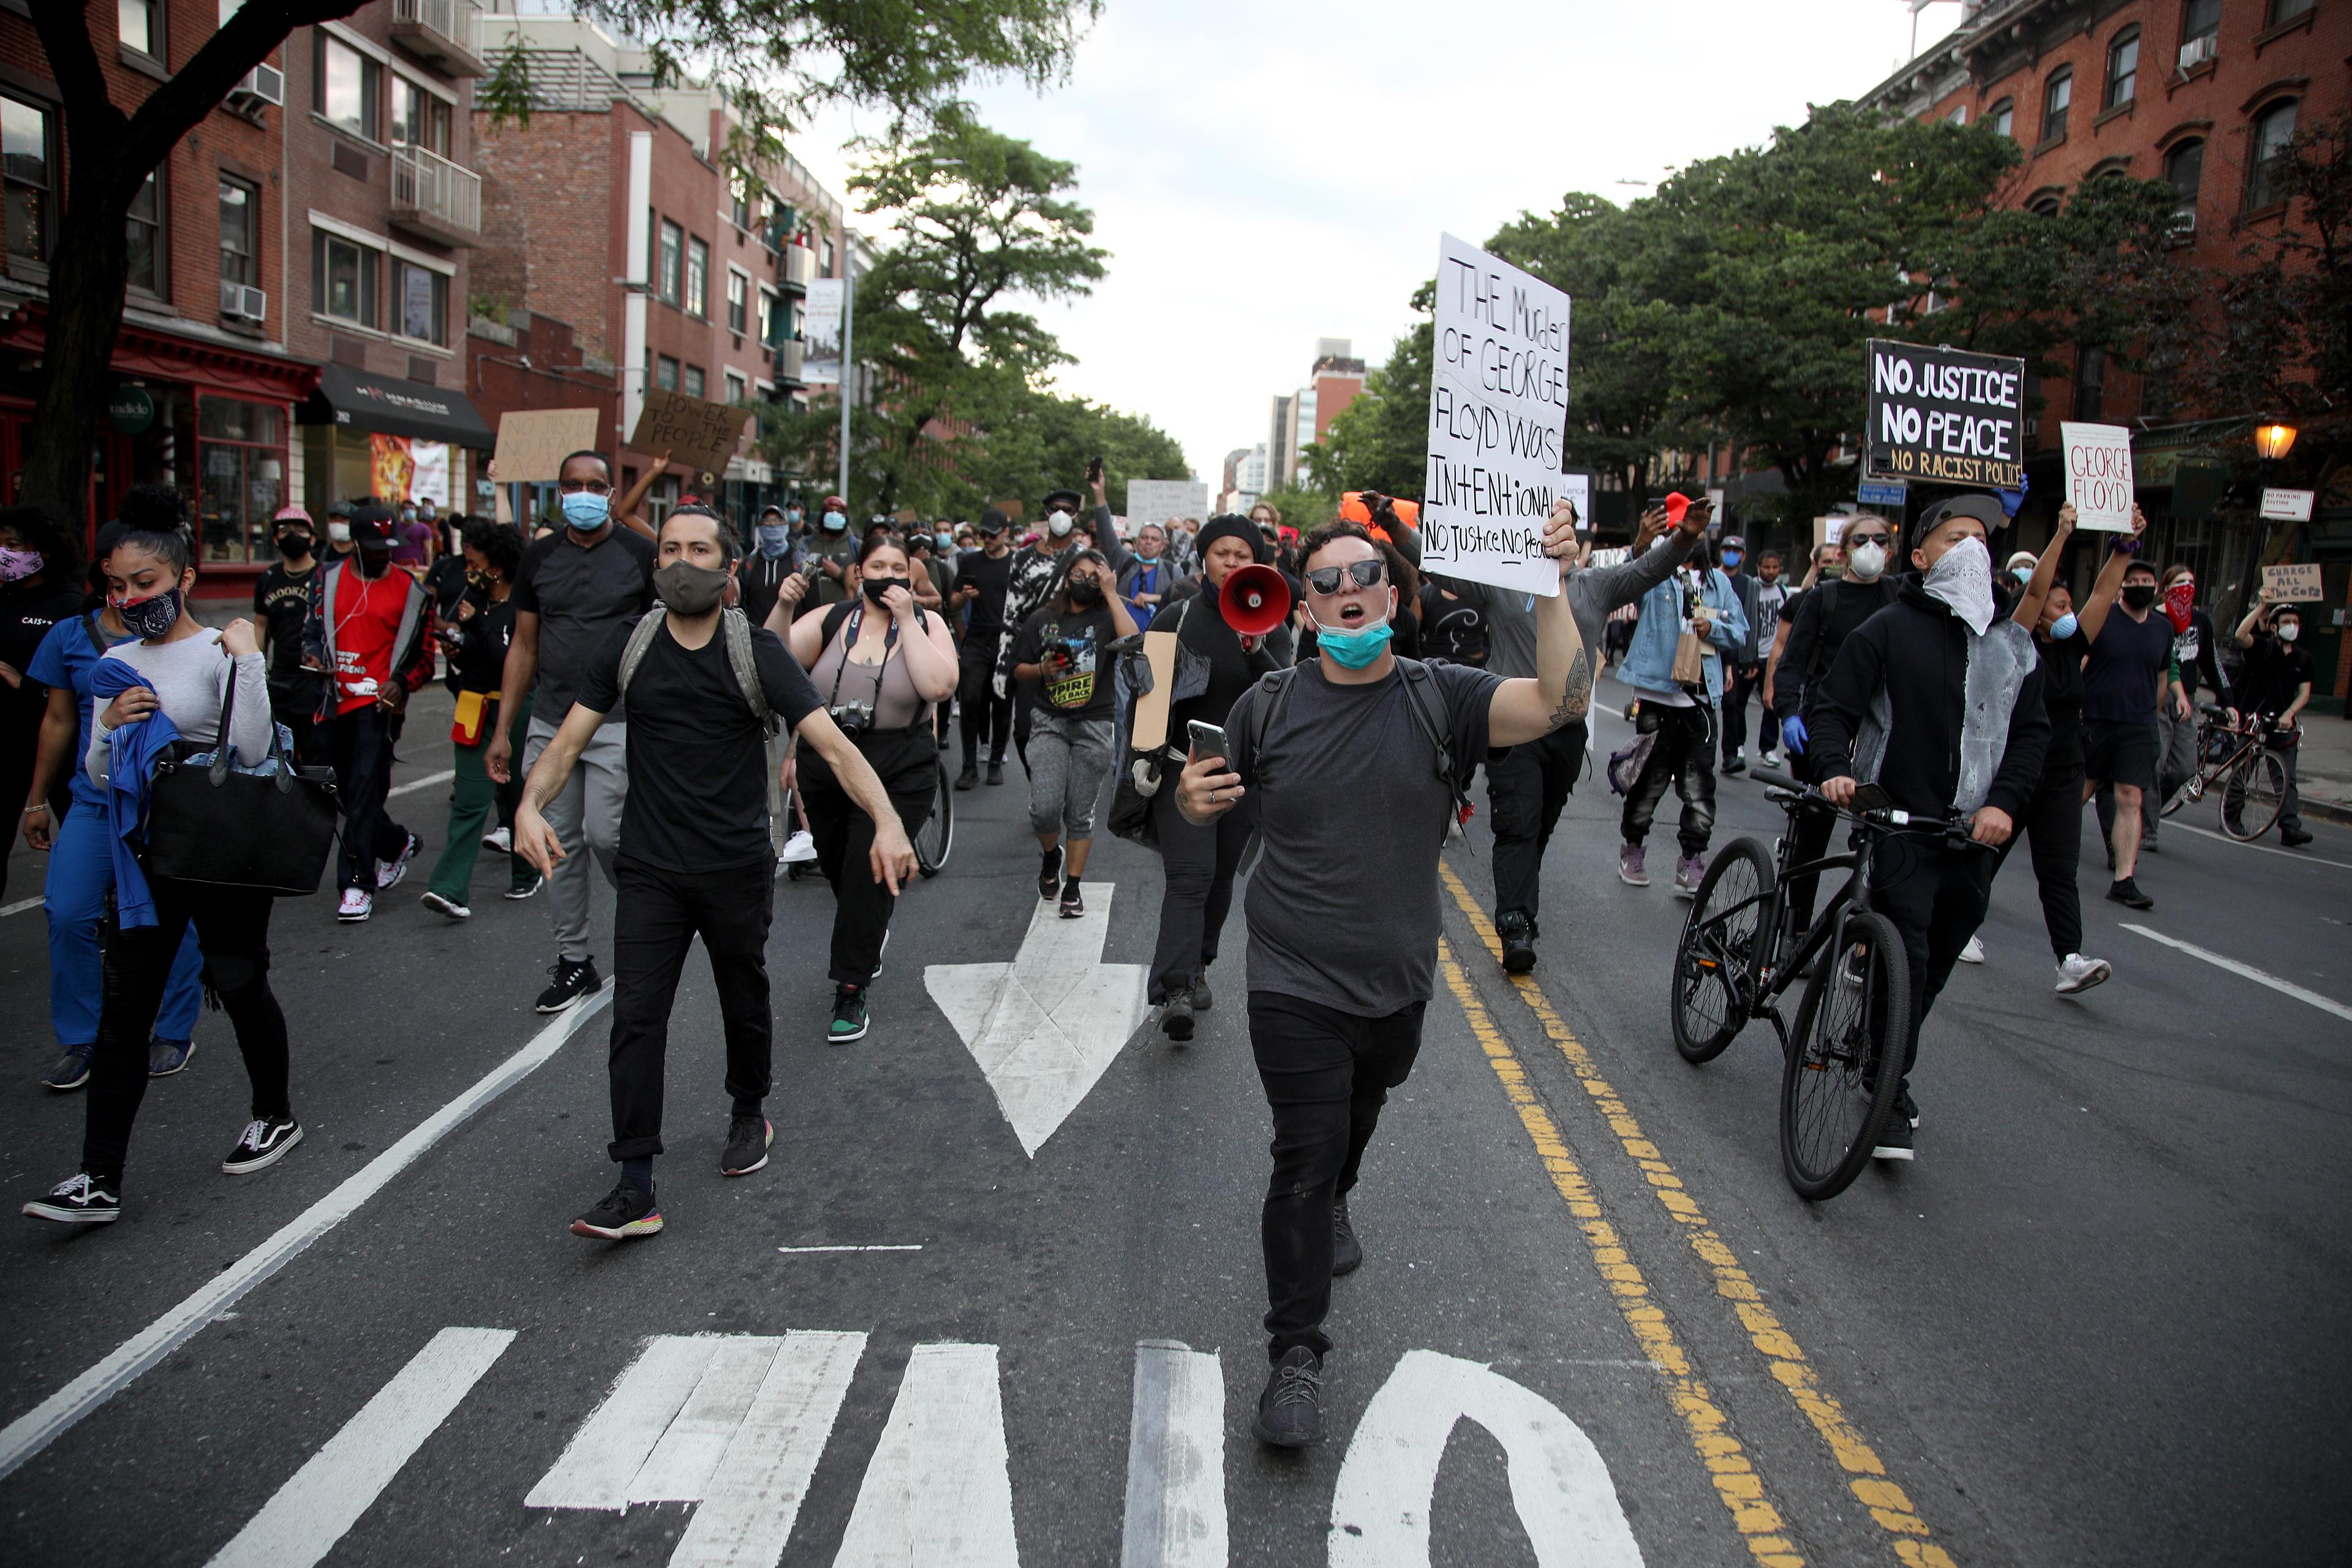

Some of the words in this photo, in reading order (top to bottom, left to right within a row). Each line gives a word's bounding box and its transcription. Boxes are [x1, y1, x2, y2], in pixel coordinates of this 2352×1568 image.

[1448, 257, 1507, 332] THE
[1512, 285, 1567, 352] Murder
[1443, 328, 1472, 369] OF
[1480, 337, 1565, 409] GEORGE
[1875, 353, 1913, 396] NO
[1916, 363, 2018, 409] JUSTICE
[507, 417, 533, 435] NO
[545, 414, 594, 435] JUSTICE
[649, 408, 674, 423] TO
[701, 420, 731, 438] THE
[650, 423, 729, 453] PEOPLE
[1436, 386, 1499, 457] FLOYD
[1882, 402, 1921, 445] NO
[1926, 410, 2012, 461] PEACE
[503, 438, 530, 457] NO
[2071, 445, 2130, 481] GEORGE
[508, 456, 559, 480] ACA
[1891, 448, 1913, 471] NO
[1920, 451, 1981, 481] RACIST
[1985, 461, 2021, 486] POLICE
[2075, 479, 2127, 513] FLOYD
[1426, 519, 1448, 552] NO
[1502, 528, 1523, 554] NO
[2277, 577, 2300, 586] ALL
